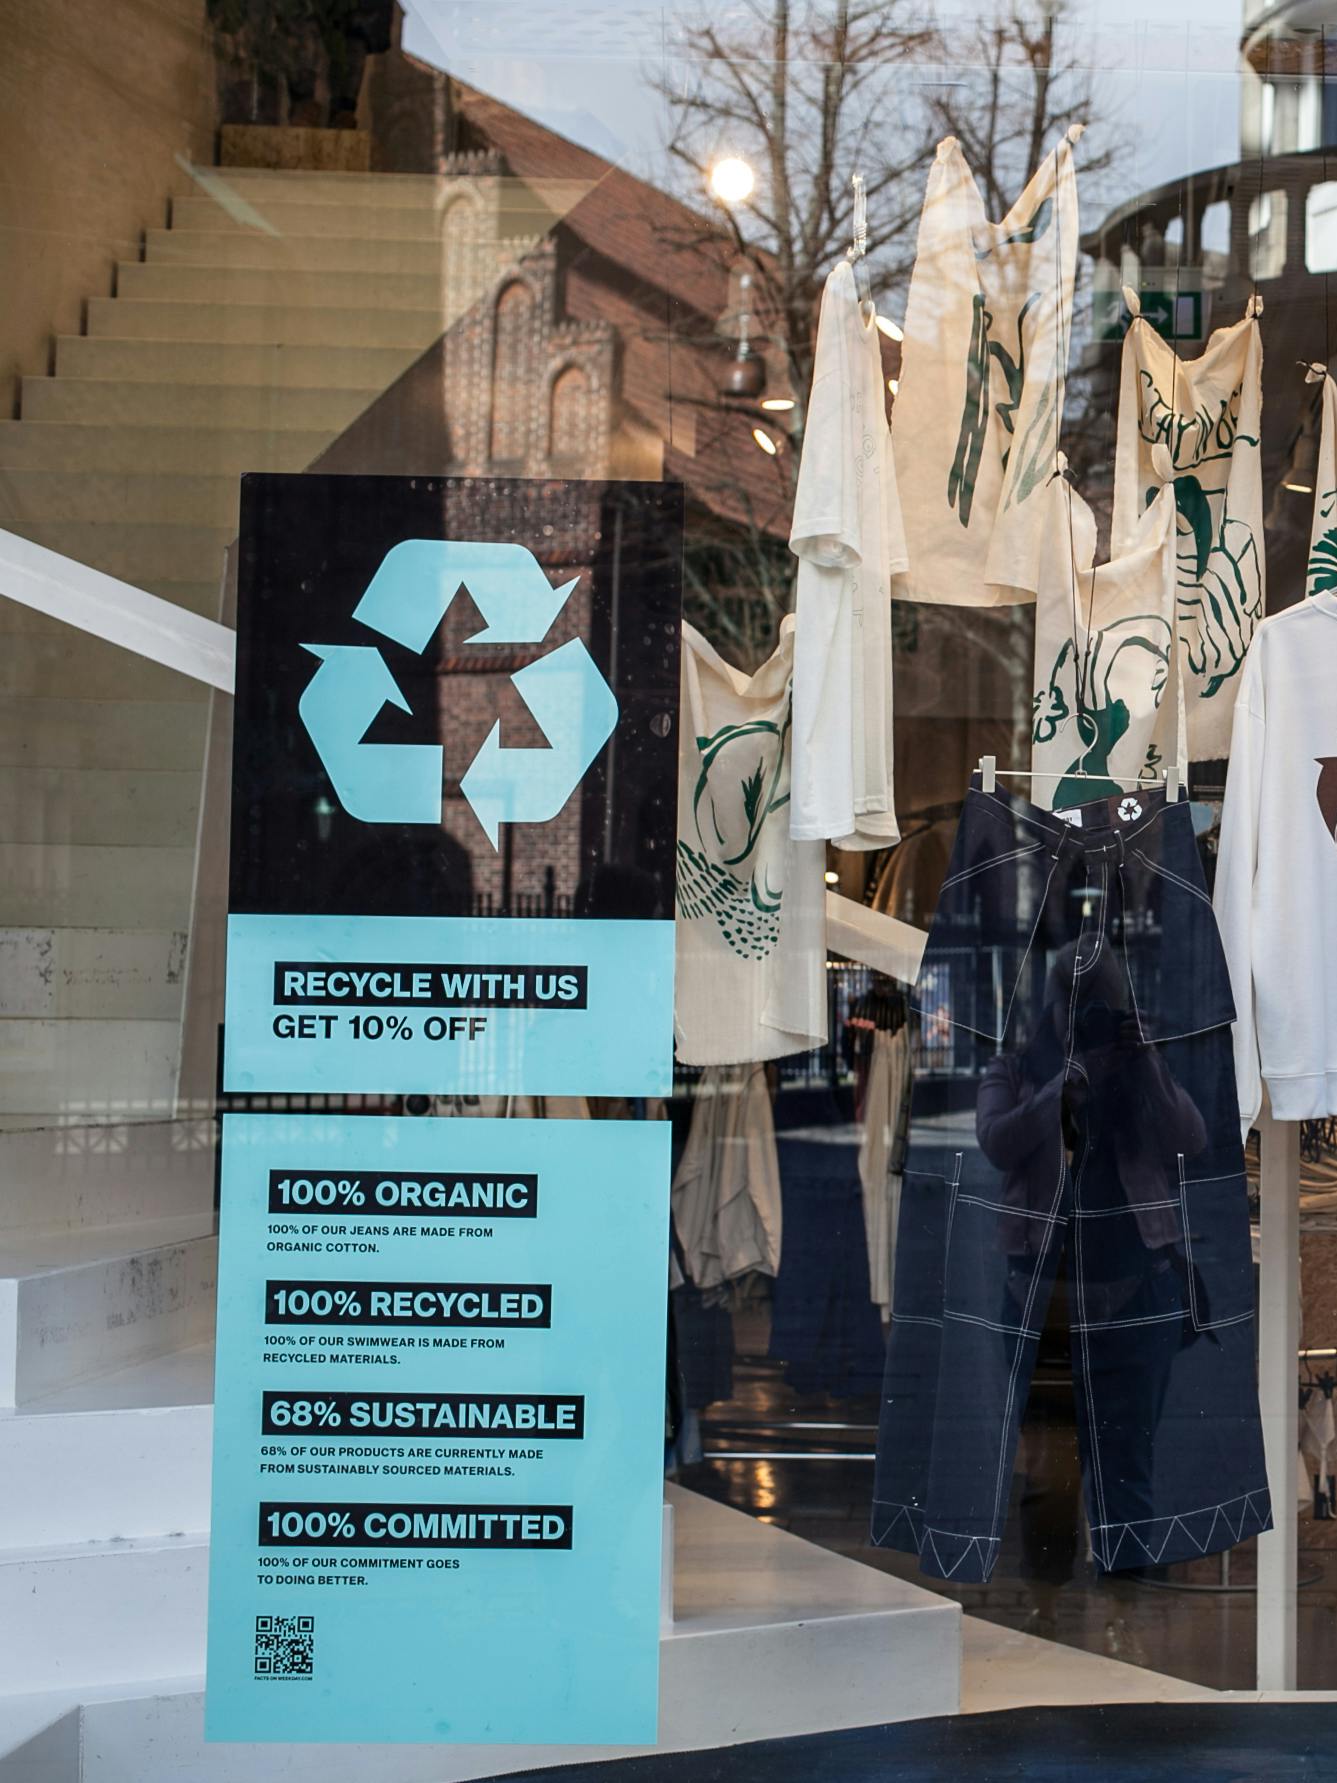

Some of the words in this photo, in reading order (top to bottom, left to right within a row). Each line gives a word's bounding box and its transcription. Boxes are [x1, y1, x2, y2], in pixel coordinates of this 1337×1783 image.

[284, 971, 431, 997] RECYCLE
[441, 974, 524, 999] WITH
[536, 975, 578, 1000] US
[273, 1015, 338, 1038] GET
[349, 1016, 412, 1040] 10%
[424, 1017, 487, 1040] OFF
[278, 1180, 365, 1206] 100%
[376, 1181, 527, 1208] ORGANIC
[269, 1224, 298, 1235] 100%
[302, 1224, 318, 1235] OF
[322, 1225, 346, 1235] OUR
[350, 1226, 389, 1236] JEANS
[393, 1226, 416, 1236] ARE
[421, 1227, 454, 1237] MADE
[459, 1227, 492, 1238] FROM
[267, 1241, 321, 1252] ORGANIC
[326, 1242, 379, 1253] COTTON.
[274, 1290, 361, 1316] 100%
[371, 1292, 543, 1318] RECYCLED
[265, 1335, 295, 1346] 100%
[300, 1336, 315, 1346] OF
[319, 1336, 343, 1346] OUR
[348, 1336, 414, 1347] SWIMWEAR
[419, 1337, 429, 1348] IS
[433, 1338, 466, 1348] MADE
[471, 1338, 504, 1349] FROM
[264, 1353, 326, 1364] RECYCLED
[330, 1354, 400, 1365] MATERIALS.
[271, 1401, 341, 1426] 68%
[350, 1402, 576, 1429] SUSTAINABLE
[261, 1446, 286, 1456] 68%
[291, 1446, 306, 1456] OF
[310, 1446, 335, 1457] OUR
[339, 1447, 404, 1458] PRODUCTS
[408, 1447, 431, 1458] ARE
[435, 1448, 505, 1459] CURRENTLY
[509, 1449, 542, 1460] MADE
[261, 1463, 294, 1474] FROM
[298, 1464, 379, 1475] SUSTAINABLY
[383, 1465, 440, 1476] SOURCED
[444, 1466, 514, 1477] MATERIALS.
[268, 1512, 355, 1537] 100%
[364, 1513, 564, 1539] COMMITTED
[258, 1557, 289, 1568] 100%
[293, 1557, 308, 1568] OF
[312, 1558, 337, 1568] OUR
[341, 1558, 423, 1569] COMMITMENT
[427, 1559, 459, 1569] GOES
[258, 1574, 273, 1585] TO
[276, 1575, 314, 1585] DOING
[318, 1575, 368, 1586] BETTER.
